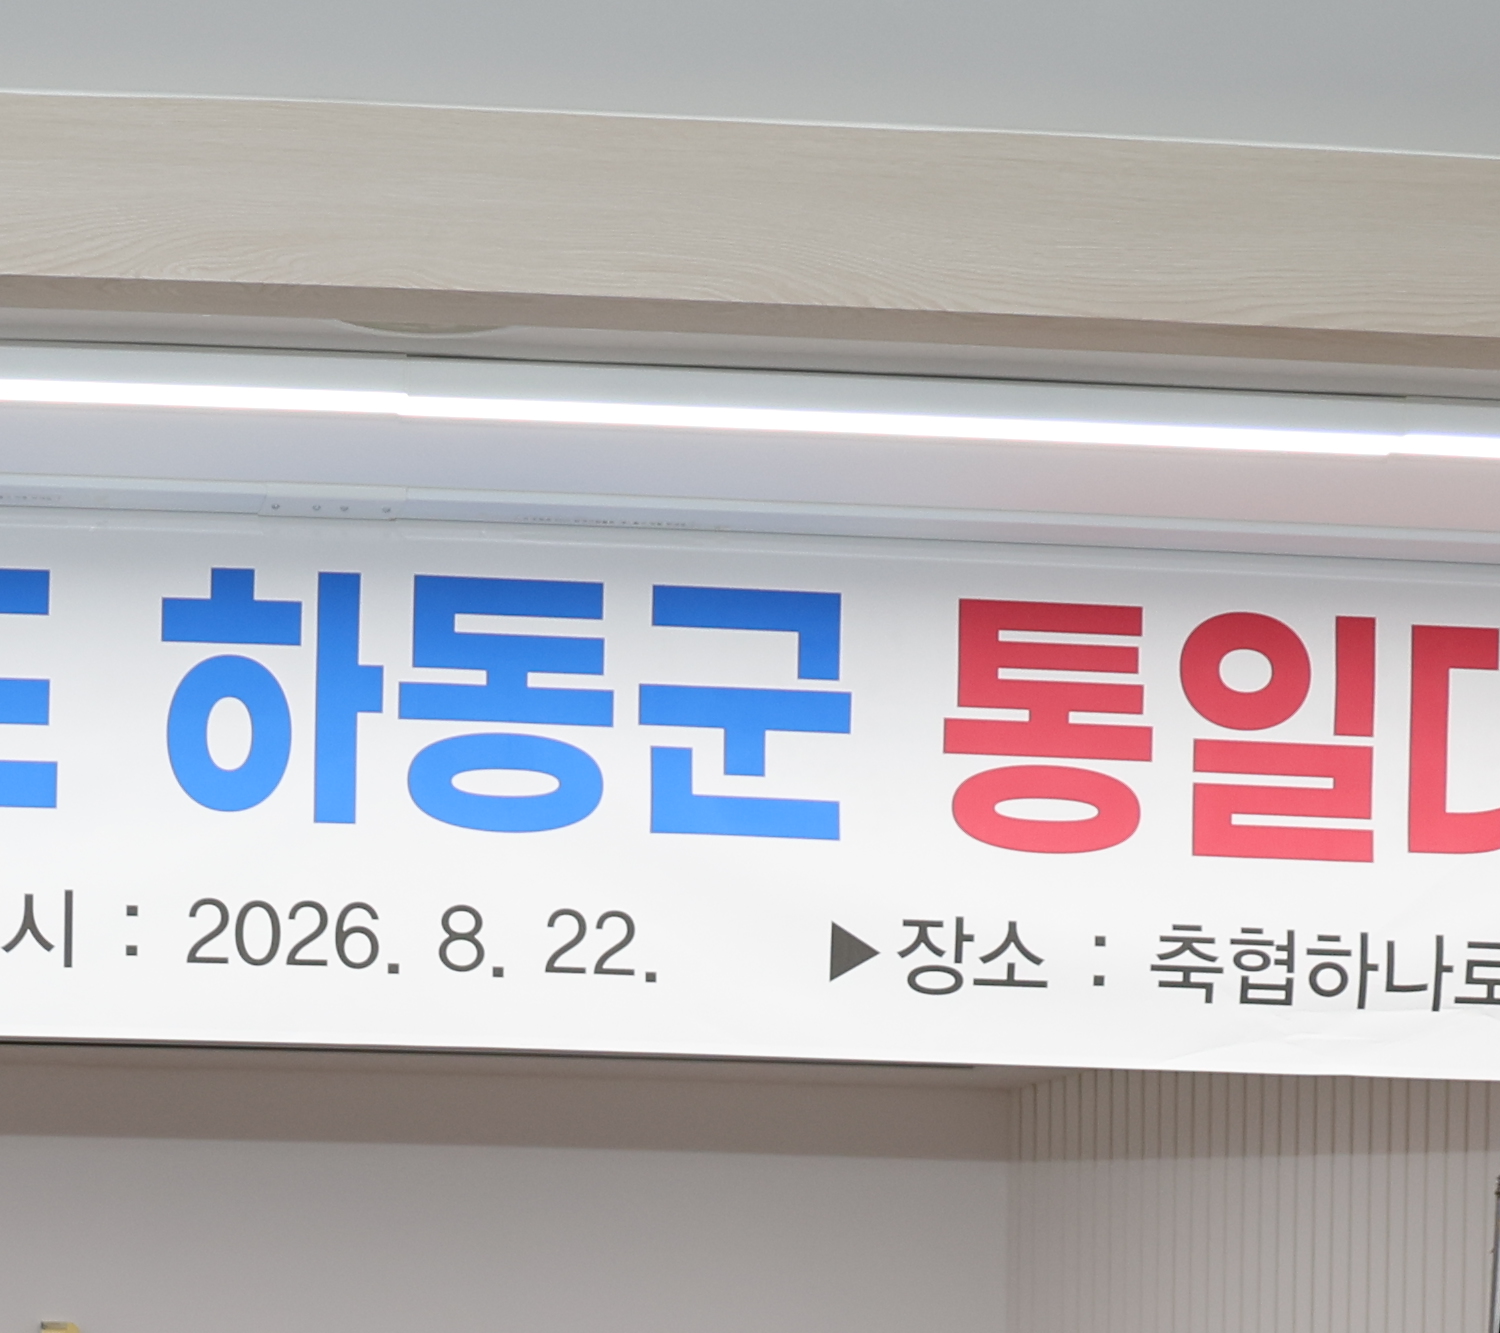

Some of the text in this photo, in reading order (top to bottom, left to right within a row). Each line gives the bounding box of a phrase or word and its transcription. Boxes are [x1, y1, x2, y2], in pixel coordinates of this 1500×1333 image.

[160, 562, 853, 842] 하동군
[186, 897, 401, 976] 2026.
[438, 904, 506, 979] 8.
[544, 908, 658, 984] 22.
[896, 916, 1049, 996] 장소
